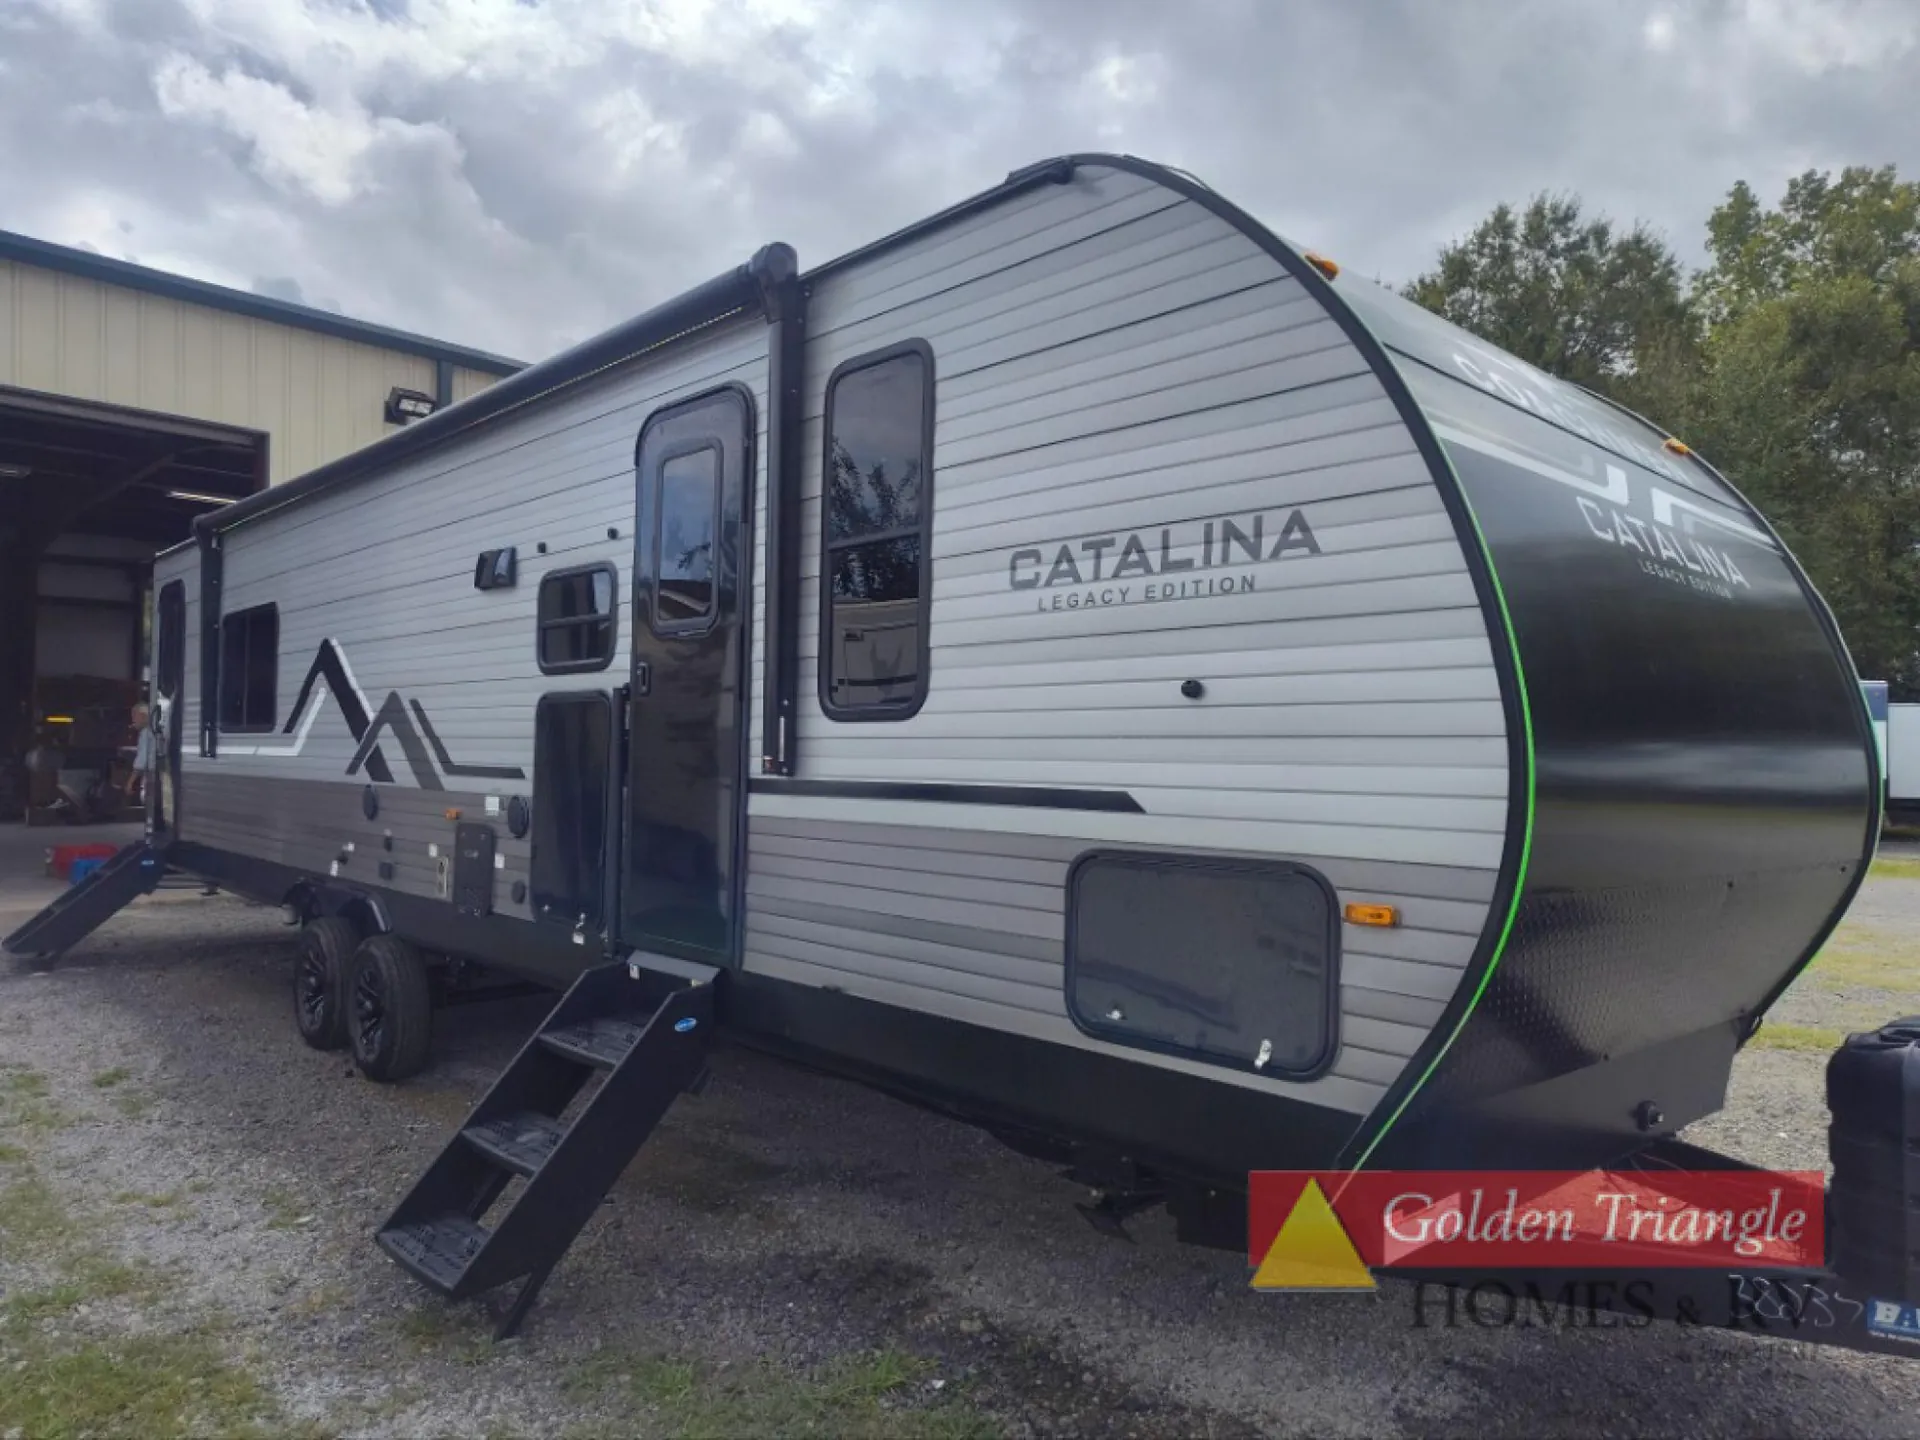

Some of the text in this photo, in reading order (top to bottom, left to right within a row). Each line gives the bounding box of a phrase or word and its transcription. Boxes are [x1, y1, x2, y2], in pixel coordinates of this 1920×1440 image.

[1010, 508, 1323, 591] CATALINA
[1575, 495, 1752, 589] CATALINA
[1038, 574, 1257, 613] LEGACY EDITION
